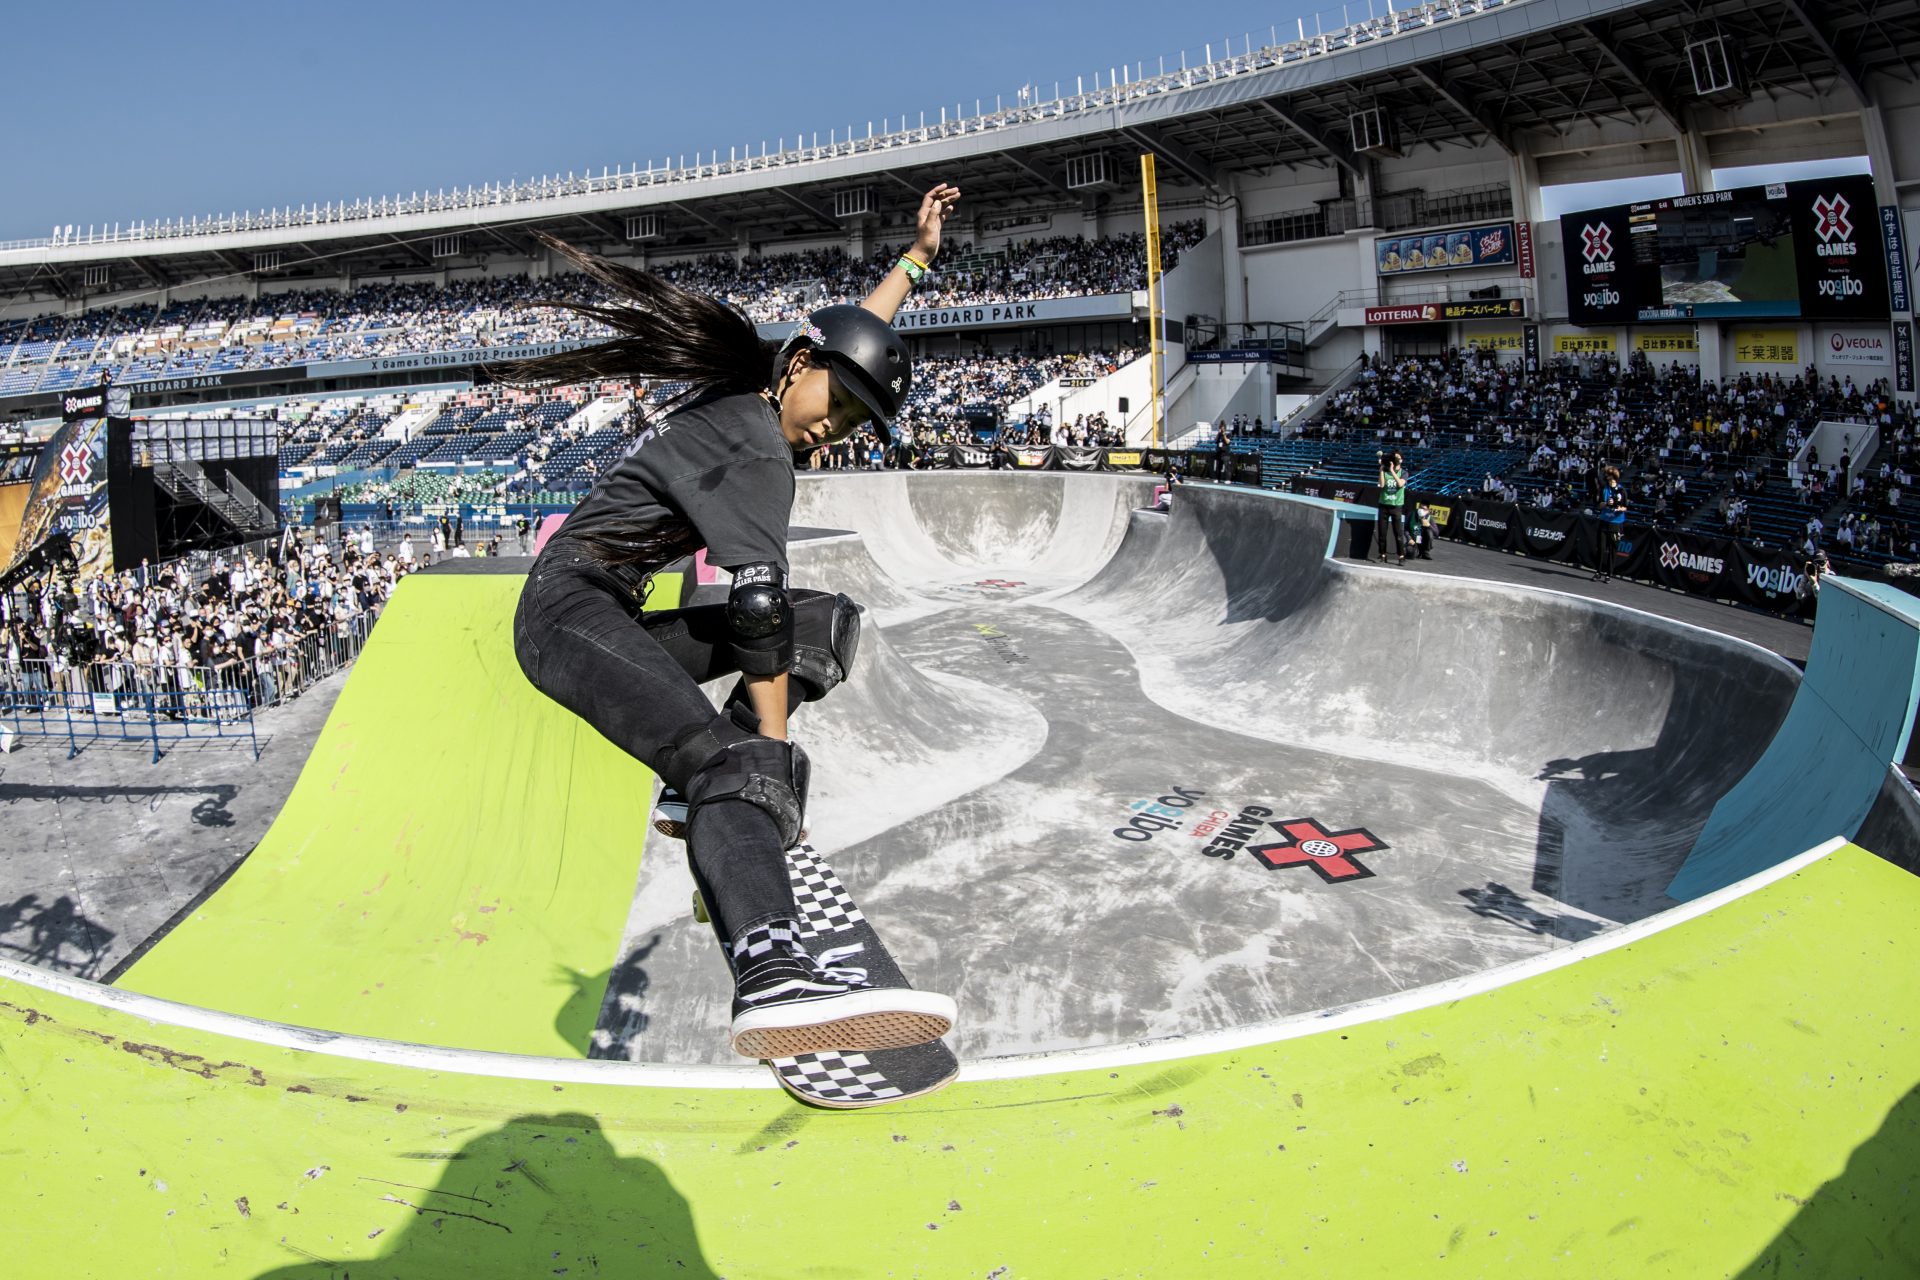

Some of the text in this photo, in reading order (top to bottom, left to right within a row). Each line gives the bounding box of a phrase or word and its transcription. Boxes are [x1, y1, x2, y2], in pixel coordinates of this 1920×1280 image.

[1673, 195, 1702, 208] WOMEN'S
[1716, 191, 1733, 202] PARK
[1519, 223, 1532, 278] KEMITEC
[1816, 242, 1857, 256] GAMES
[1884, 208, 1905, 309] みずほ信託銀行
[1583, 261, 1616, 274] GAMES
[1819, 275, 1863, 296] yogibo
[1584, 289, 1620, 306] yogibo
[889, 304, 1036, 327] KATEBOARD PARK
[1368, 309, 1419, 321] LOTTERIA
[1446, 304, 1507, 316] 絶品チーズバーガー
[1846, 338, 1883, 349] VEOLIA
[372, 361, 378, 370] X
[383, 358, 419, 370] Games
[424, 354, 456, 366] Chiba
[462, 351, 489, 362] 2022
[493, 345, 556, 359] Presented
[130, 375, 222, 394] ATEBOARD PARK
[77, 395, 102, 408] GAMES
[60, 483, 93, 497] GAMES
[60, 511, 96, 529] yogibo
[1679, 552, 1724, 574] GAMES
[735, 566, 769, 581] 187
[753, 575, 771, 583] PADS
[1112, 785, 1206, 842] yogibo
[1188, 810, 1229, 838] CHIBA
[1201, 805, 1273, 861] GAMES
